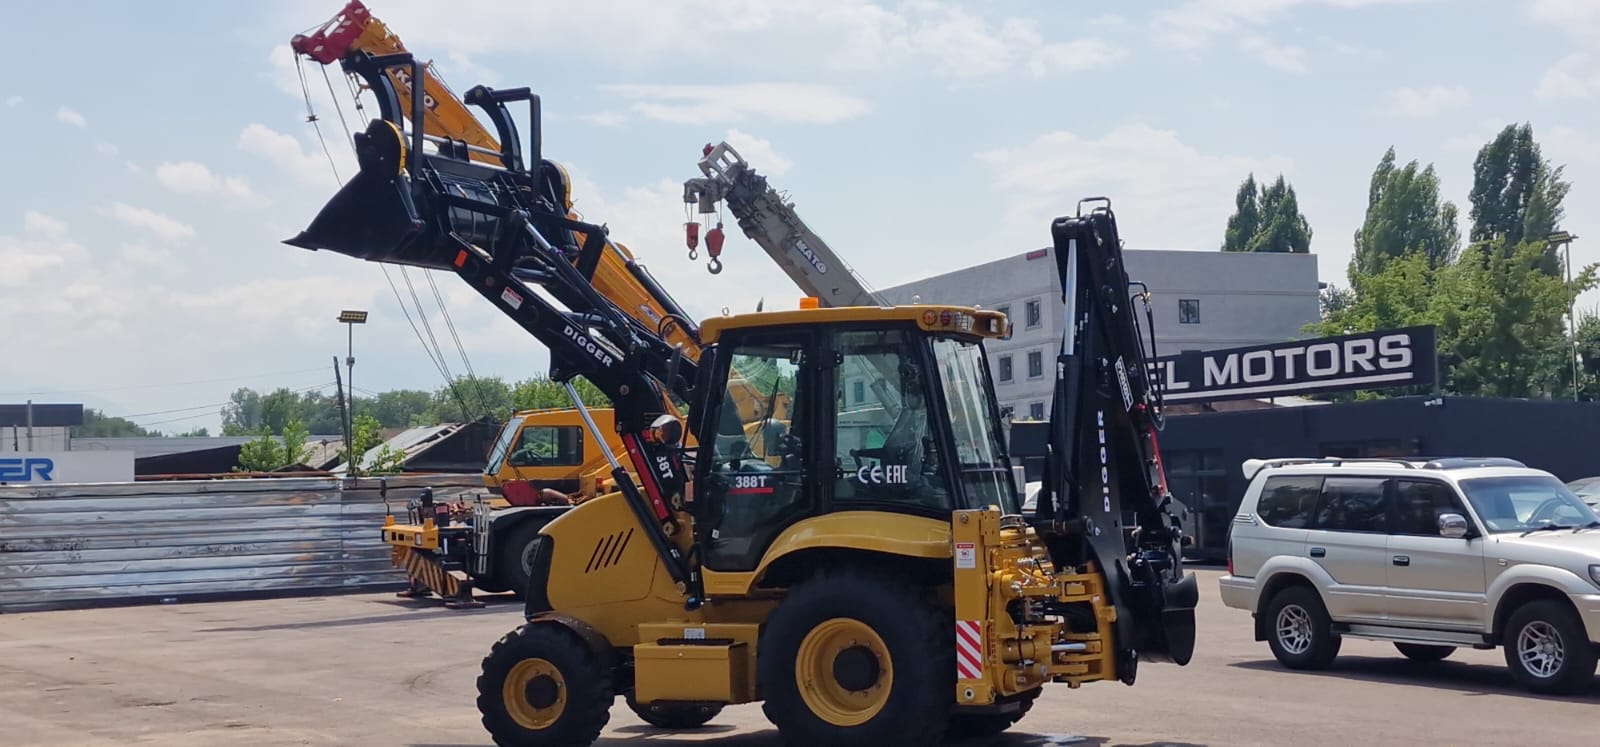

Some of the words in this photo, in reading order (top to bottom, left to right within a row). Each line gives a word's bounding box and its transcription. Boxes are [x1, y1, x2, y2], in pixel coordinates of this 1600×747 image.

[795, 240, 827, 274] KATO
[563, 325, 614, 368] DIGGER
[1203, 333, 1413, 387] MOTORS
[0, 458, 54, 481] ER
[857, 465, 882, 484] CE
[886, 465, 908, 484] EAC
[1097, 410, 1111, 513] DIGGER
[735, 475, 768, 489] 388T
